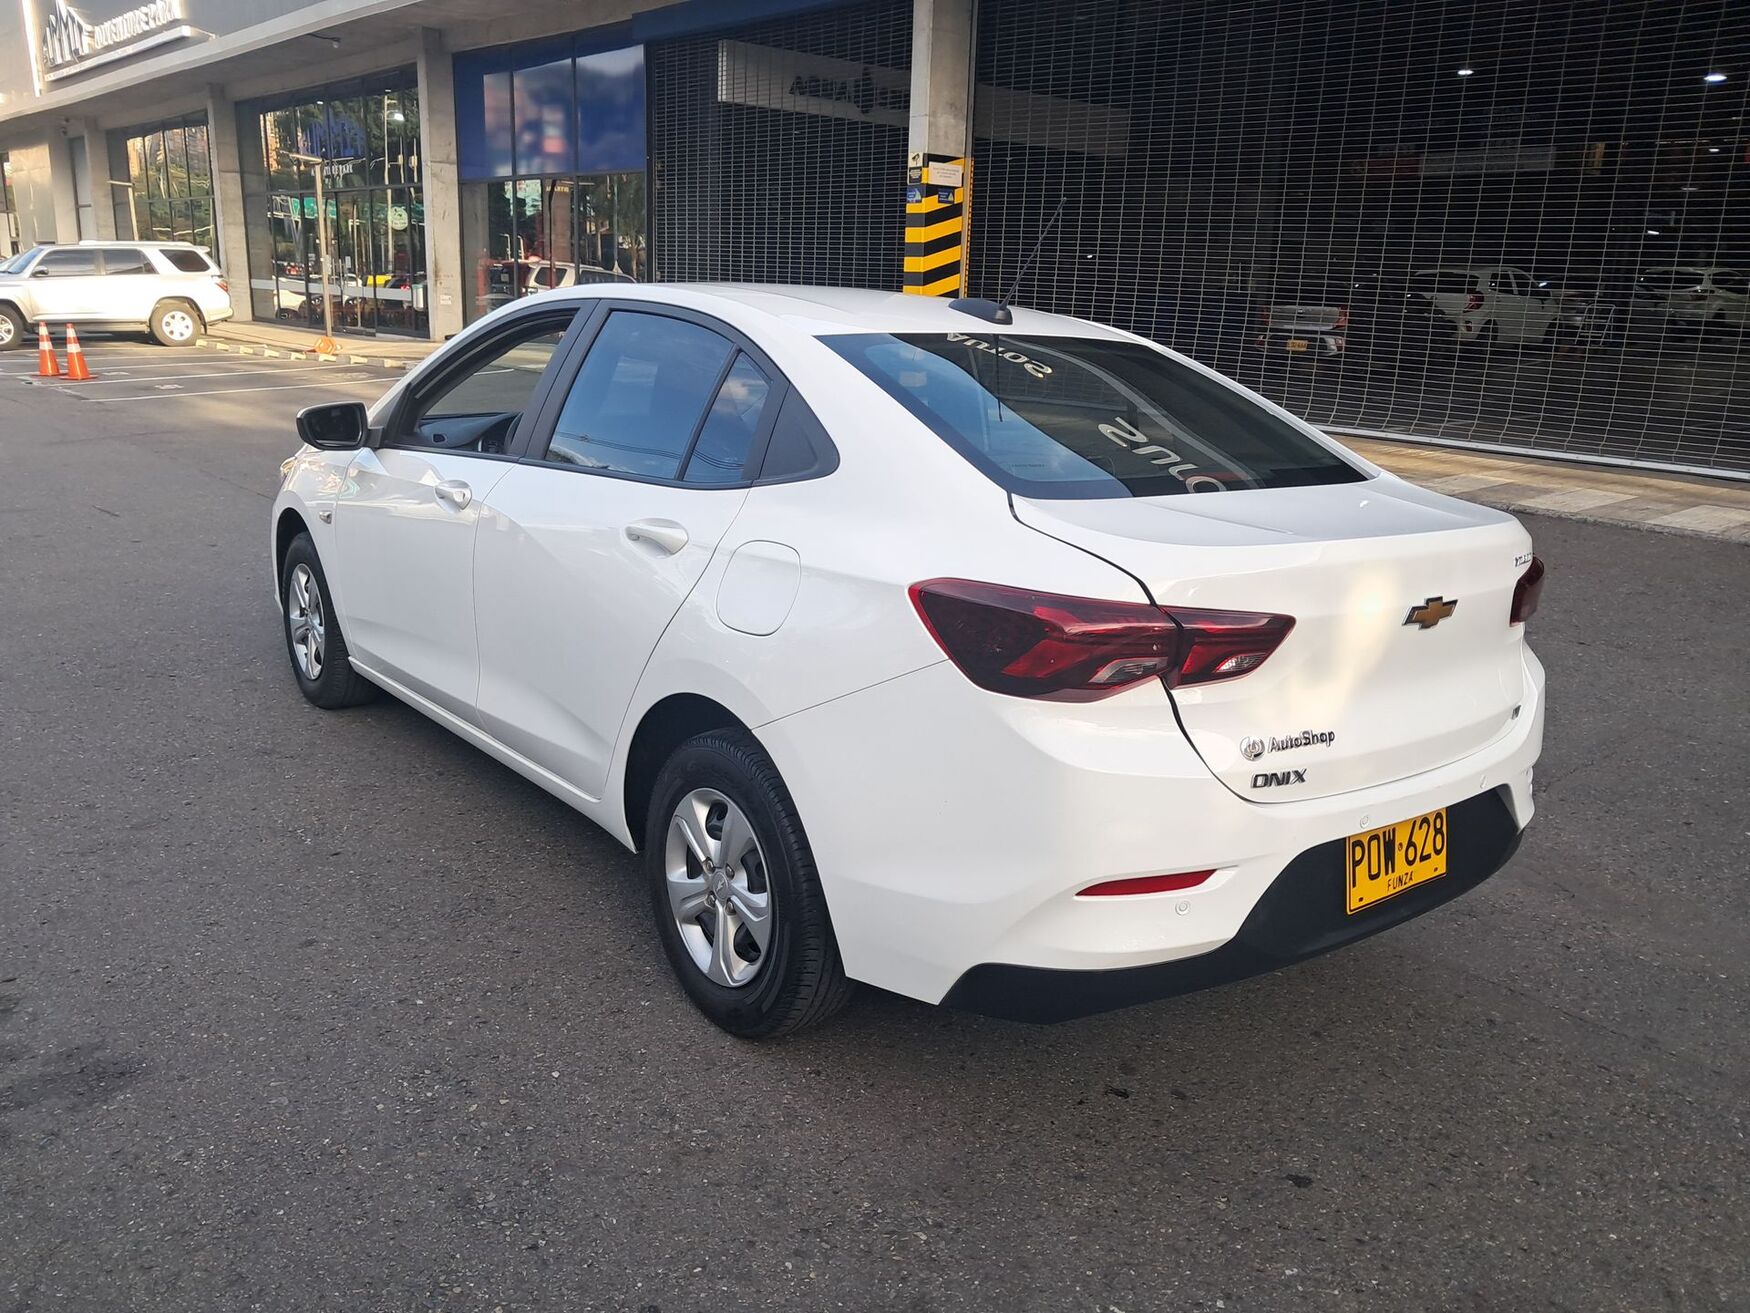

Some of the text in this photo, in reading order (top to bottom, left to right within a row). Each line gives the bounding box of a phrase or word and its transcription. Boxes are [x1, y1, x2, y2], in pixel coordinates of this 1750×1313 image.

[1267, 730, 1335, 753] AutoShop
[1250, 768, 1307, 788] ONIX
[1404, 812, 1445, 866] 628
[1387, 871, 1414, 891] FUNZA
